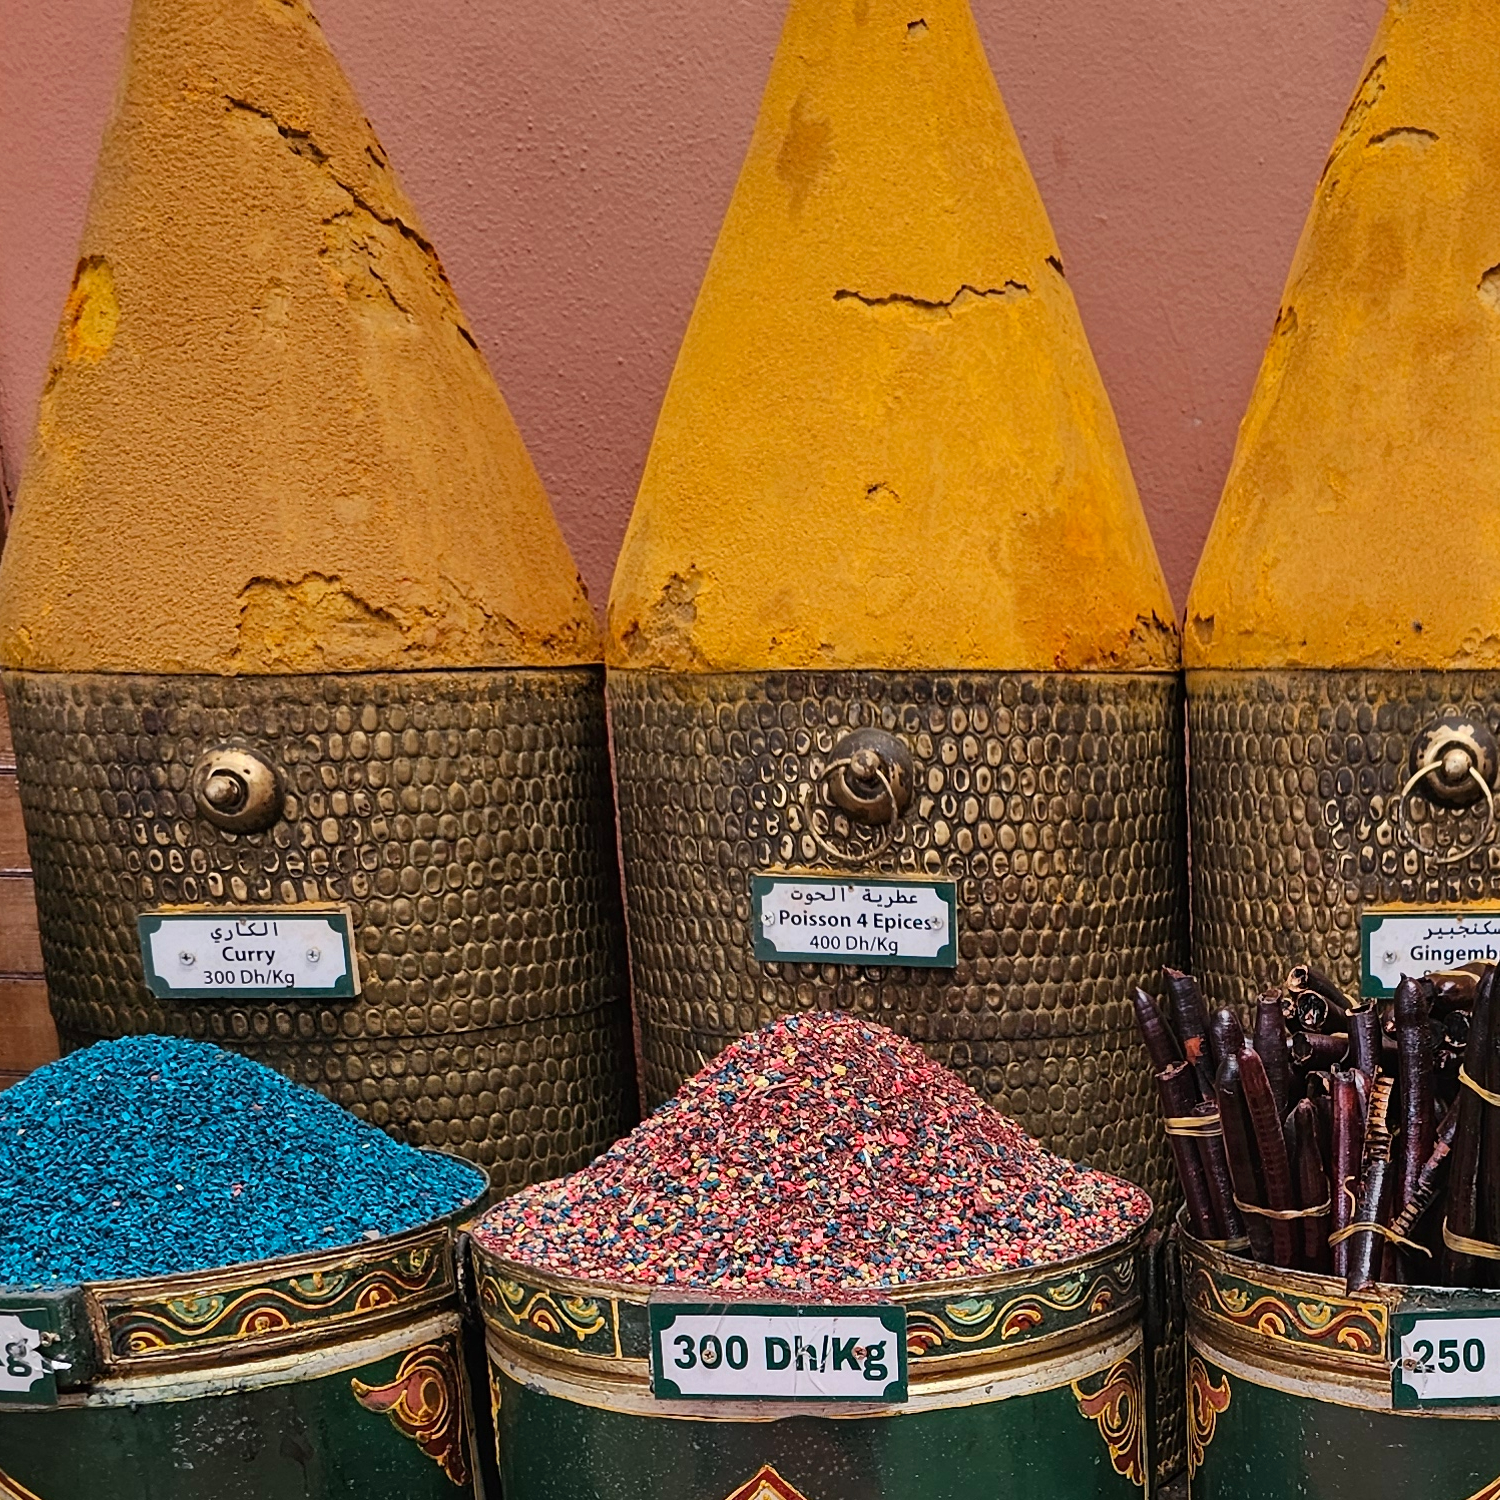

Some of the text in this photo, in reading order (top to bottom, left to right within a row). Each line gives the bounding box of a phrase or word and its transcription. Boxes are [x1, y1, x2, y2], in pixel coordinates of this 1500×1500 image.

[791, 887, 918, 907] عطرية الحوت
[779, 910, 932, 933] Poisson 4 Epices
[210, 922, 279, 943] الكاري
[809, 935, 898, 955] 400 Dh/Kg
[222, 946, 276, 965] Curry
[204, 970, 295, 988] 300 Dh/Kg
[673, 1334, 889, 1381] 300 Dh/Kg
[1412, 1338, 1486, 1374] 250
